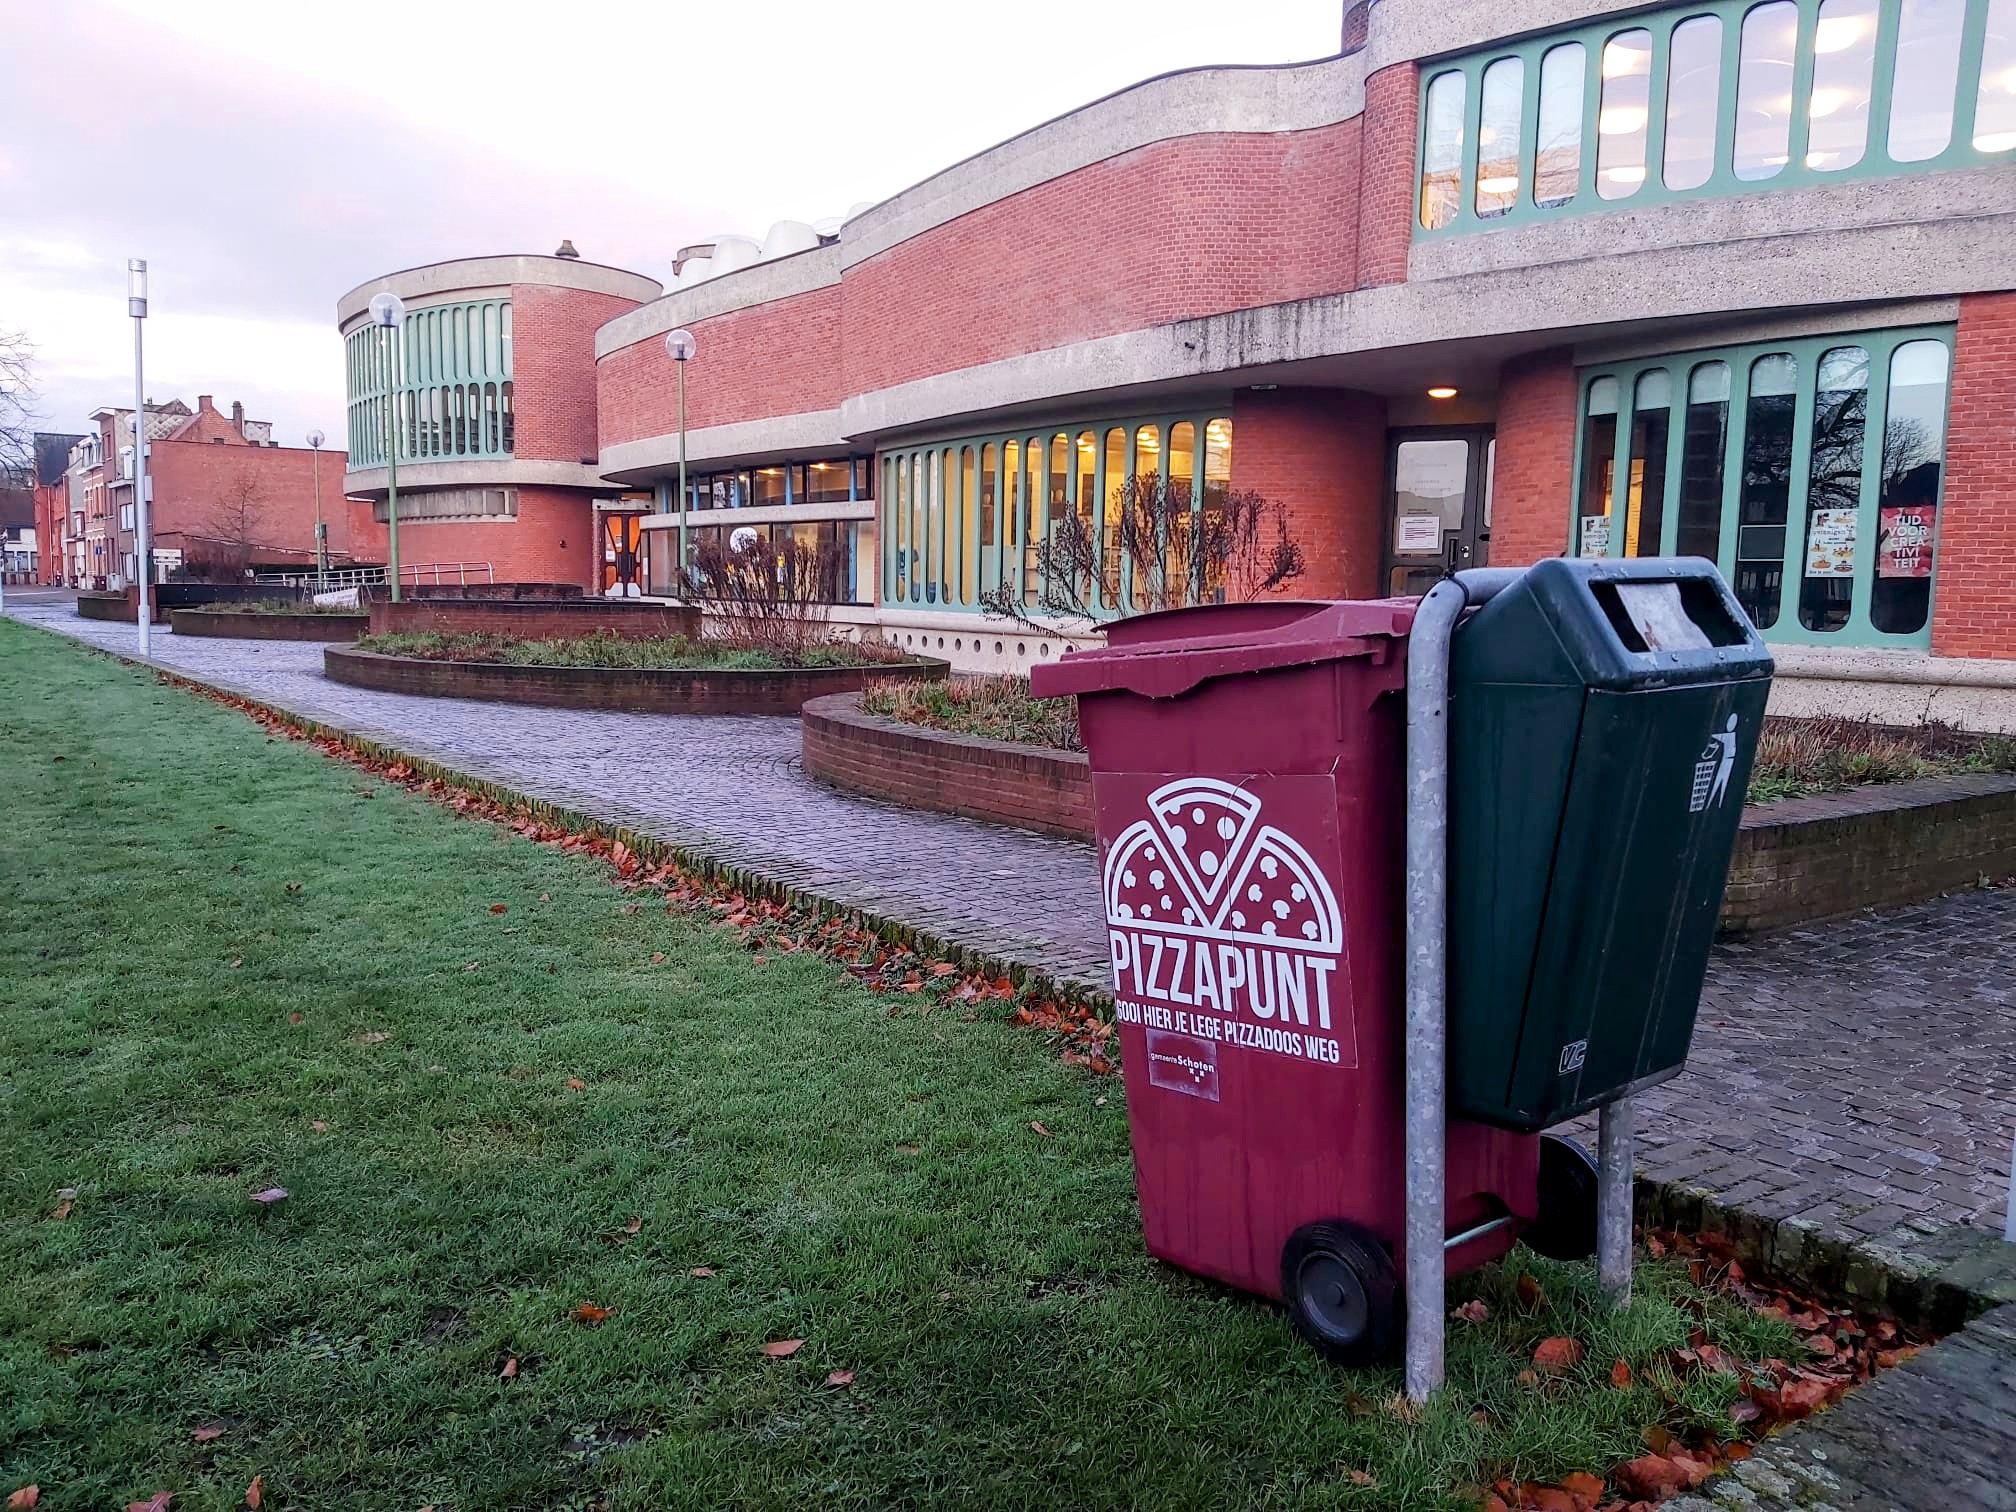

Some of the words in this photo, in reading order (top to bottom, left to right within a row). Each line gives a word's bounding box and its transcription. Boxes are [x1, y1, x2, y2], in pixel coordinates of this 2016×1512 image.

[1895, 515, 1921, 526] TIJD
[1888, 526, 1928, 537] VOOR
[1890, 536, 1926, 547] CREA
[1895, 547, 1919, 558] TIVI
[1893, 557, 1921, 568] TEIT
[1109, 929, 1337, 1030] PIZZAPUNT
[1116, 999, 1142, 1024] GOOI
[1143, 1005, 1172, 1030] HIER
[1174, 1011, 1188, 1034] JE
[1190, 1014, 1222, 1041] LEGE
[1224, 1020, 1302, 1056] PIZZADOOS
[1304, 1035, 1340, 1063] WEG
